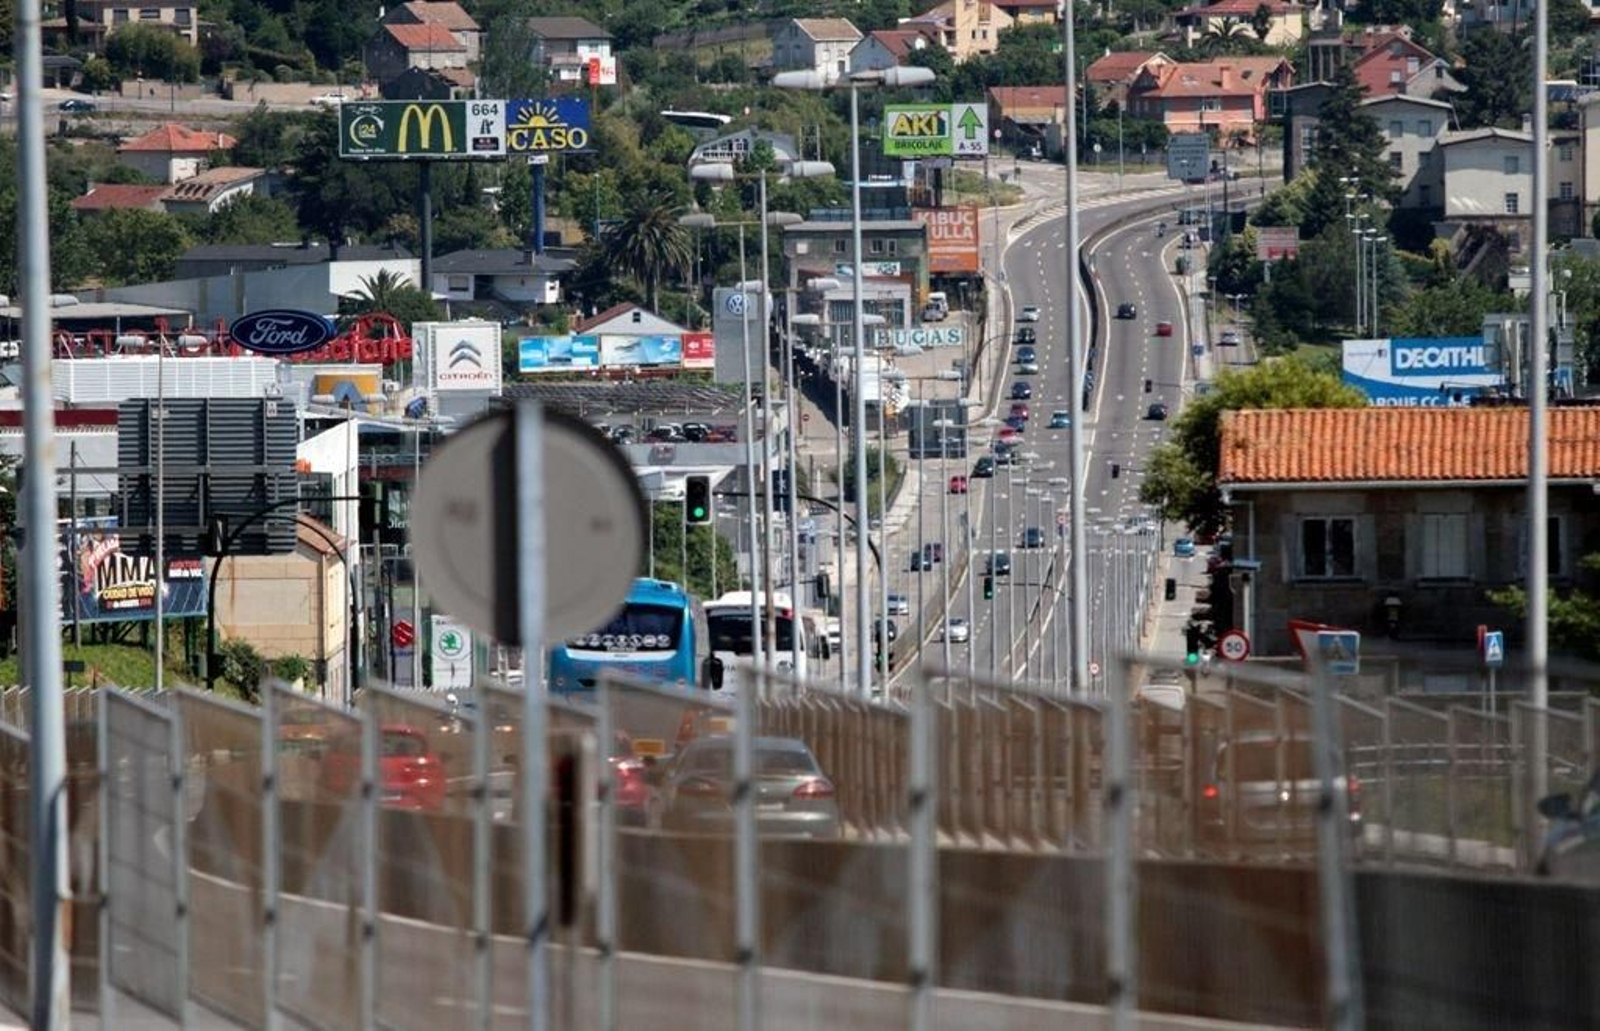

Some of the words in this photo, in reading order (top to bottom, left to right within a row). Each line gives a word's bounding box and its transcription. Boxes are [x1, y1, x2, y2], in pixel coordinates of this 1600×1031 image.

[471, 103, 499, 116] 664
[892, 112, 939, 136] AKI
[506, 127, 588, 151] CASO
[894, 141, 943, 151] BRICOLAJE
[250, 317, 307, 345] Ford
[1396, 347, 1485, 369] DECATHL
[1225, 642, 1243, 653] 50
